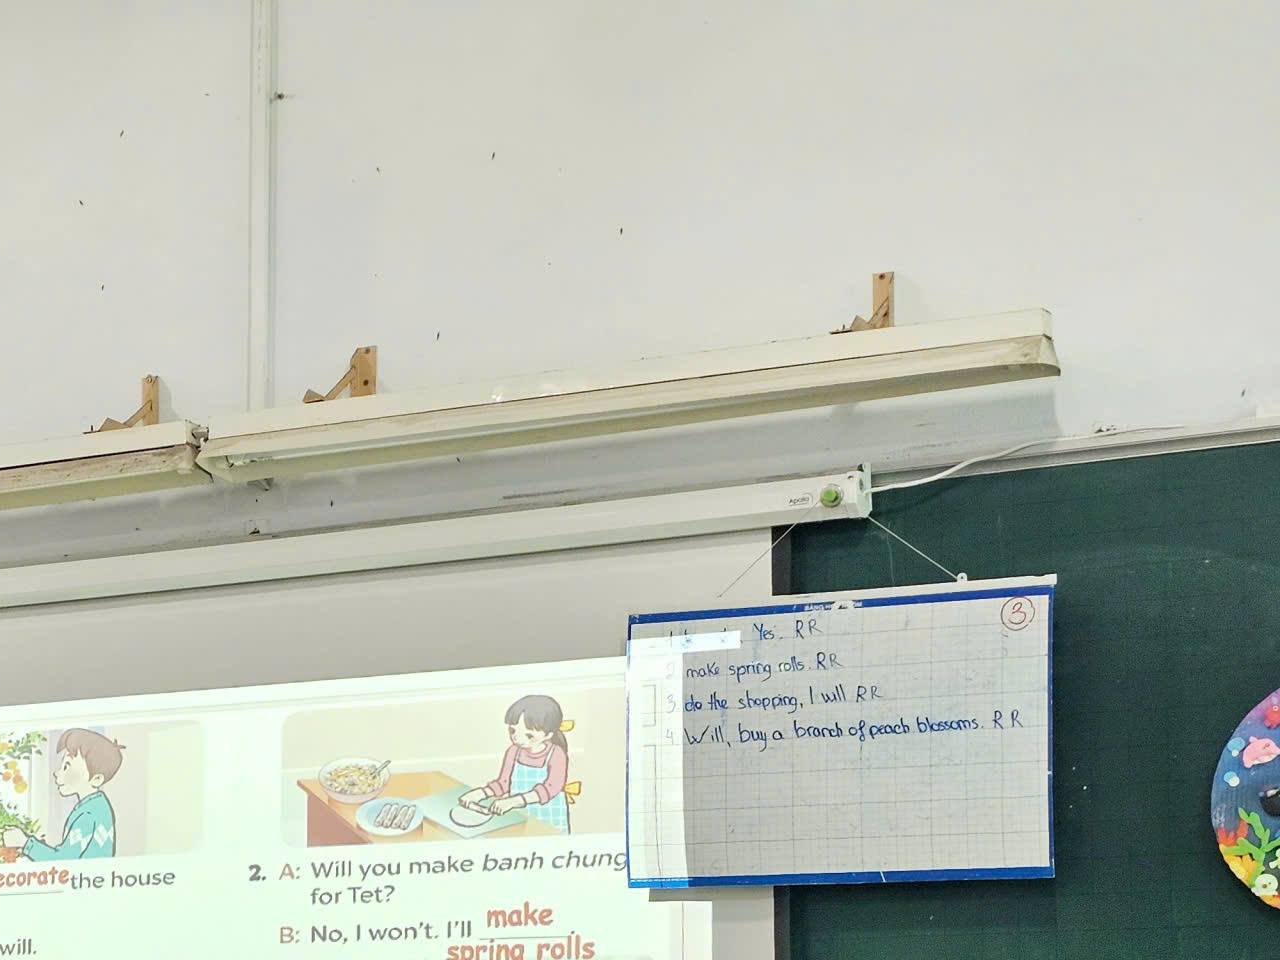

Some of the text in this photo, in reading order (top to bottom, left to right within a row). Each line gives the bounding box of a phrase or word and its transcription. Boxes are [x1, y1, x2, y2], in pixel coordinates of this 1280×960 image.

[1009, 602, 1028, 625] 3
[686, 662, 720, 679] make
[729, 660, 771, 683] spring
[684, 694, 703, 712] do
[708, 691, 729, 710] the
[738, 690, 803, 714] shopping,
[821, 684, 845, 704] will
[684, 725, 731, 748] Will,
[739, 722, 767, 752] buy
[772, 730, 784, 740] a
[794, 719, 844, 739] branch
[848, 719, 866, 742] of
[868, 722, 910, 740] peach
[916, 716, 983, 734] blossoms.
[248, 850, 627, 882] 2. A: Will you make banh chung
[70, 871, 105, 890] the
[111, 869, 176, 889] house
[310, 884, 396, 906] for Tet?
[279, 901, 554, 945] B: No, I won't. I'll make
[0, 938, 37, 956] will.
[537, 934, 596, 960] rolls
